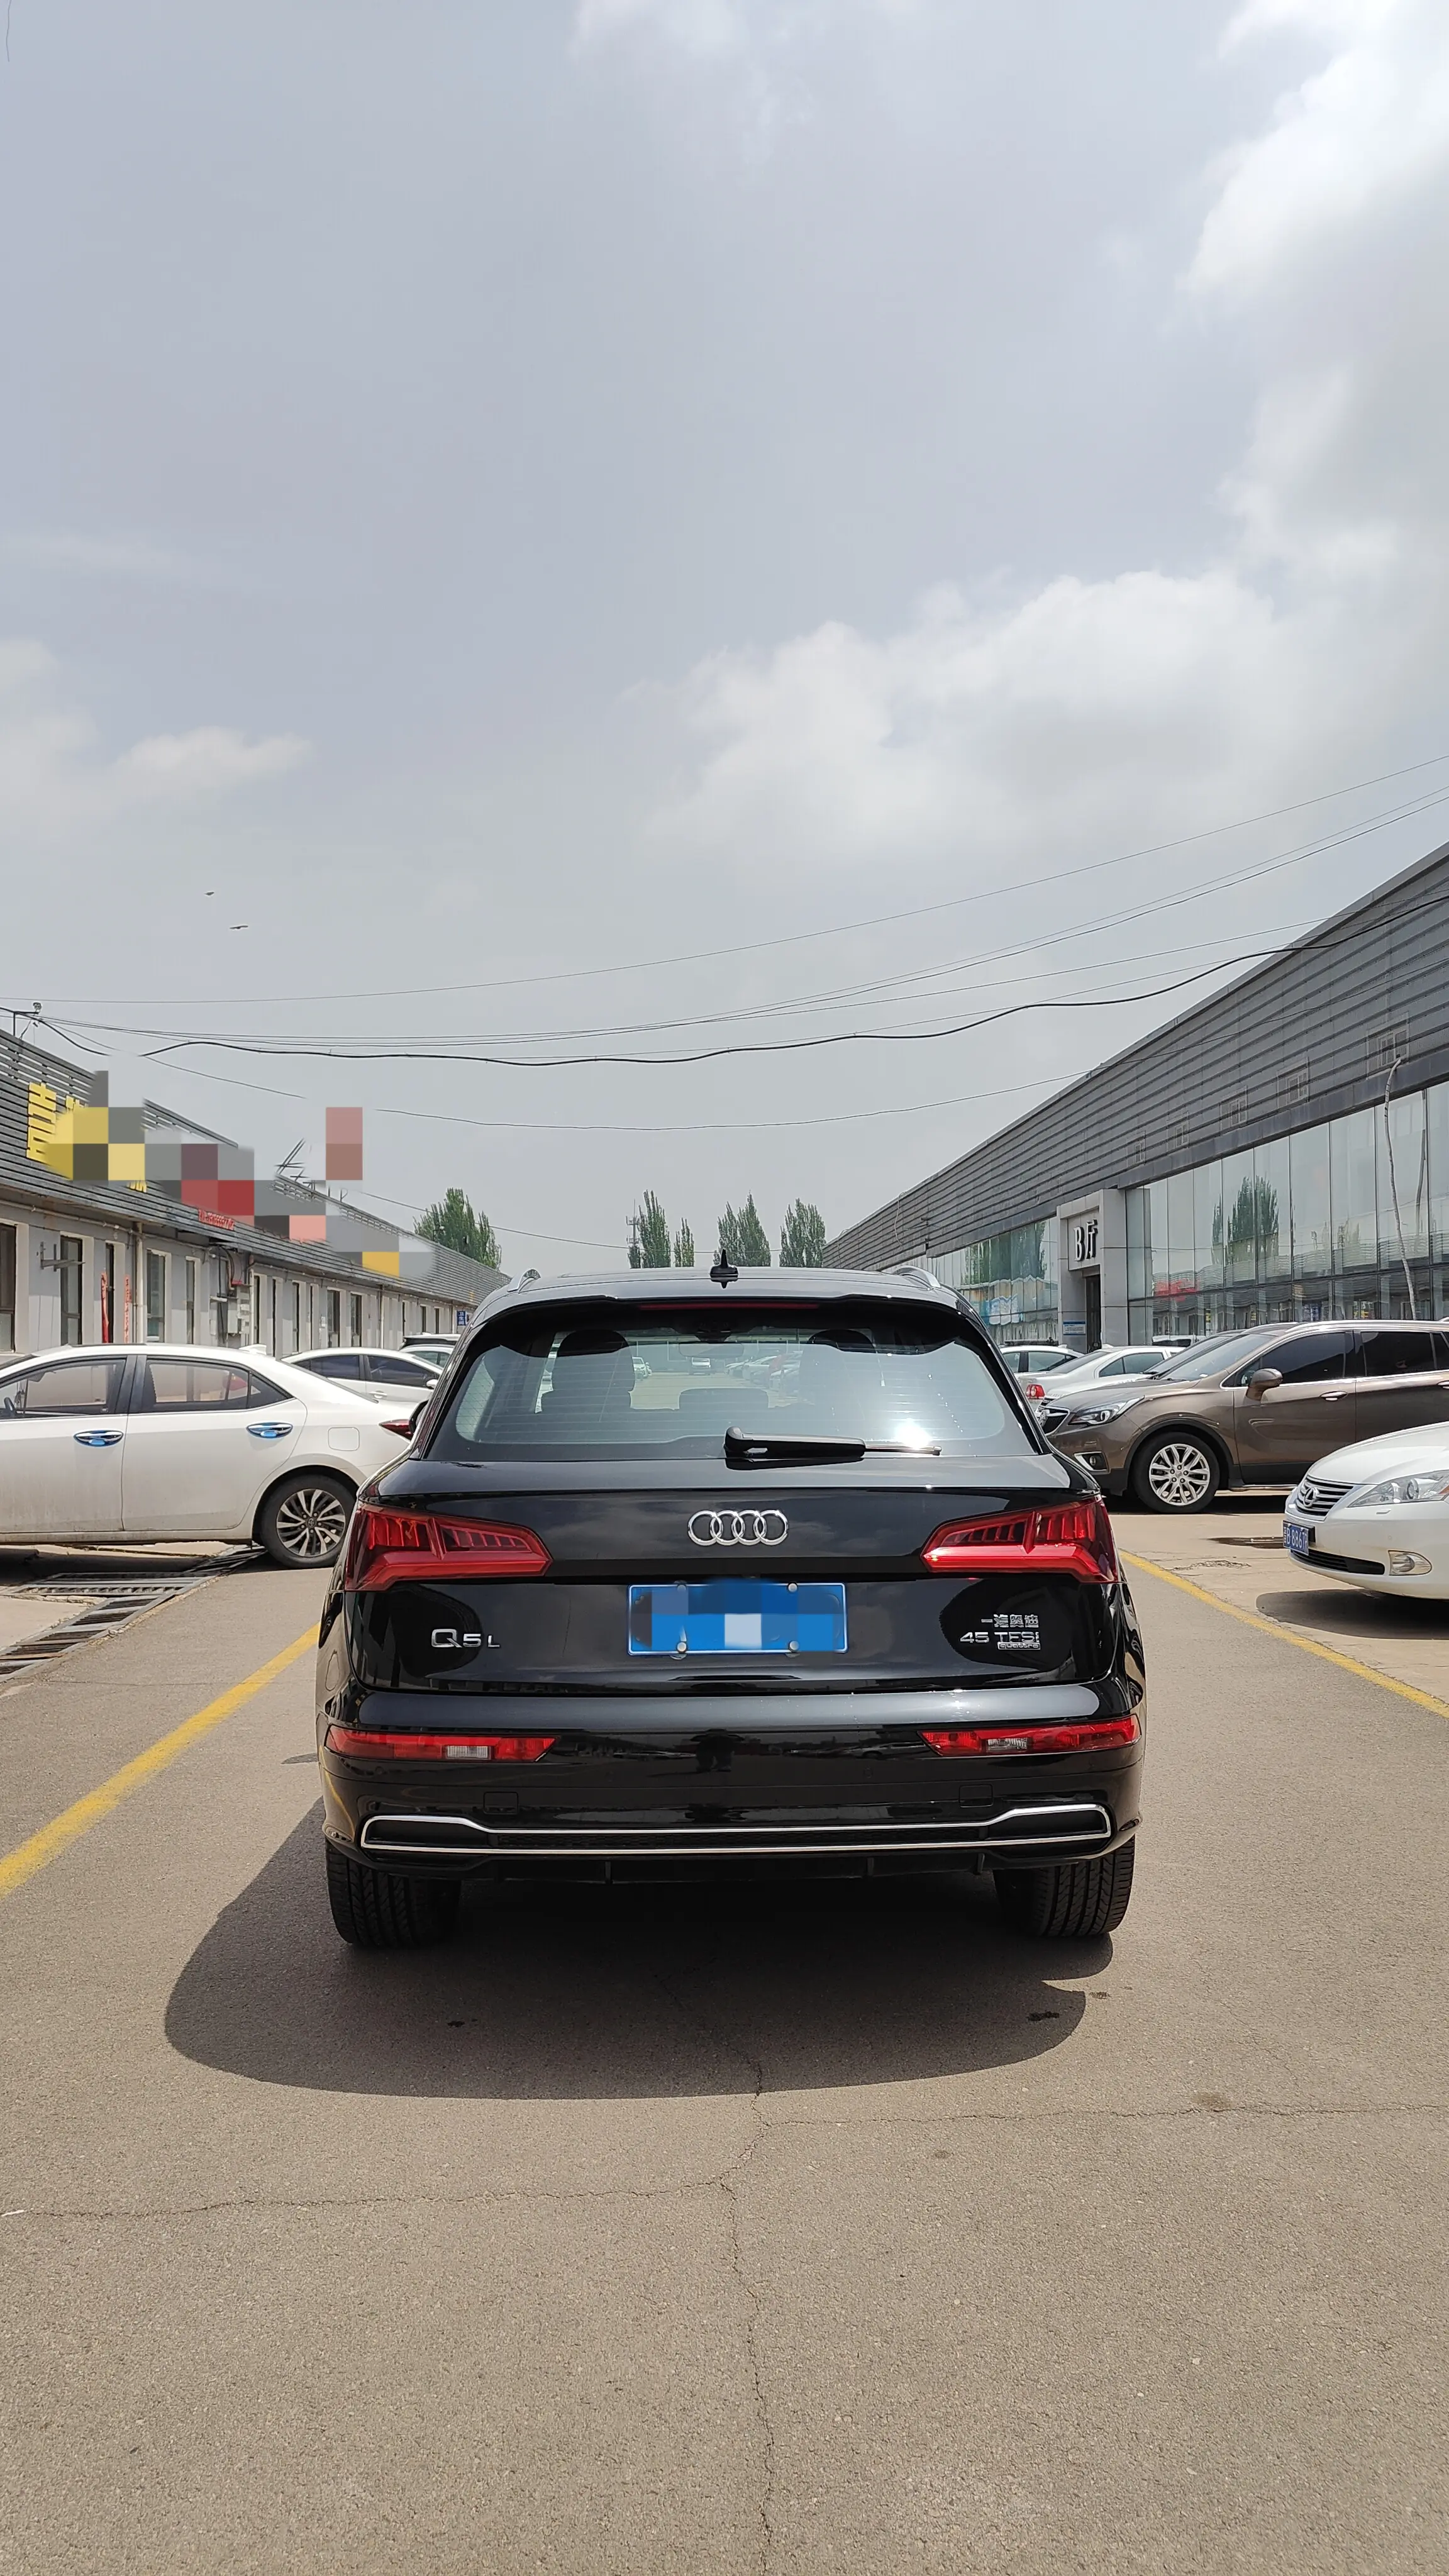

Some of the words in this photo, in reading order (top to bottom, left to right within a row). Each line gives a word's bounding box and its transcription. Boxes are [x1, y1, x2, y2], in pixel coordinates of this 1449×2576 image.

[1073, 1218, 1098, 1262] B厅
[981, 1614, 1039, 1628] 一汽奥迪
[960, 1631, 990, 1643] 45
[994, 1631, 1040, 1643] TFSI
